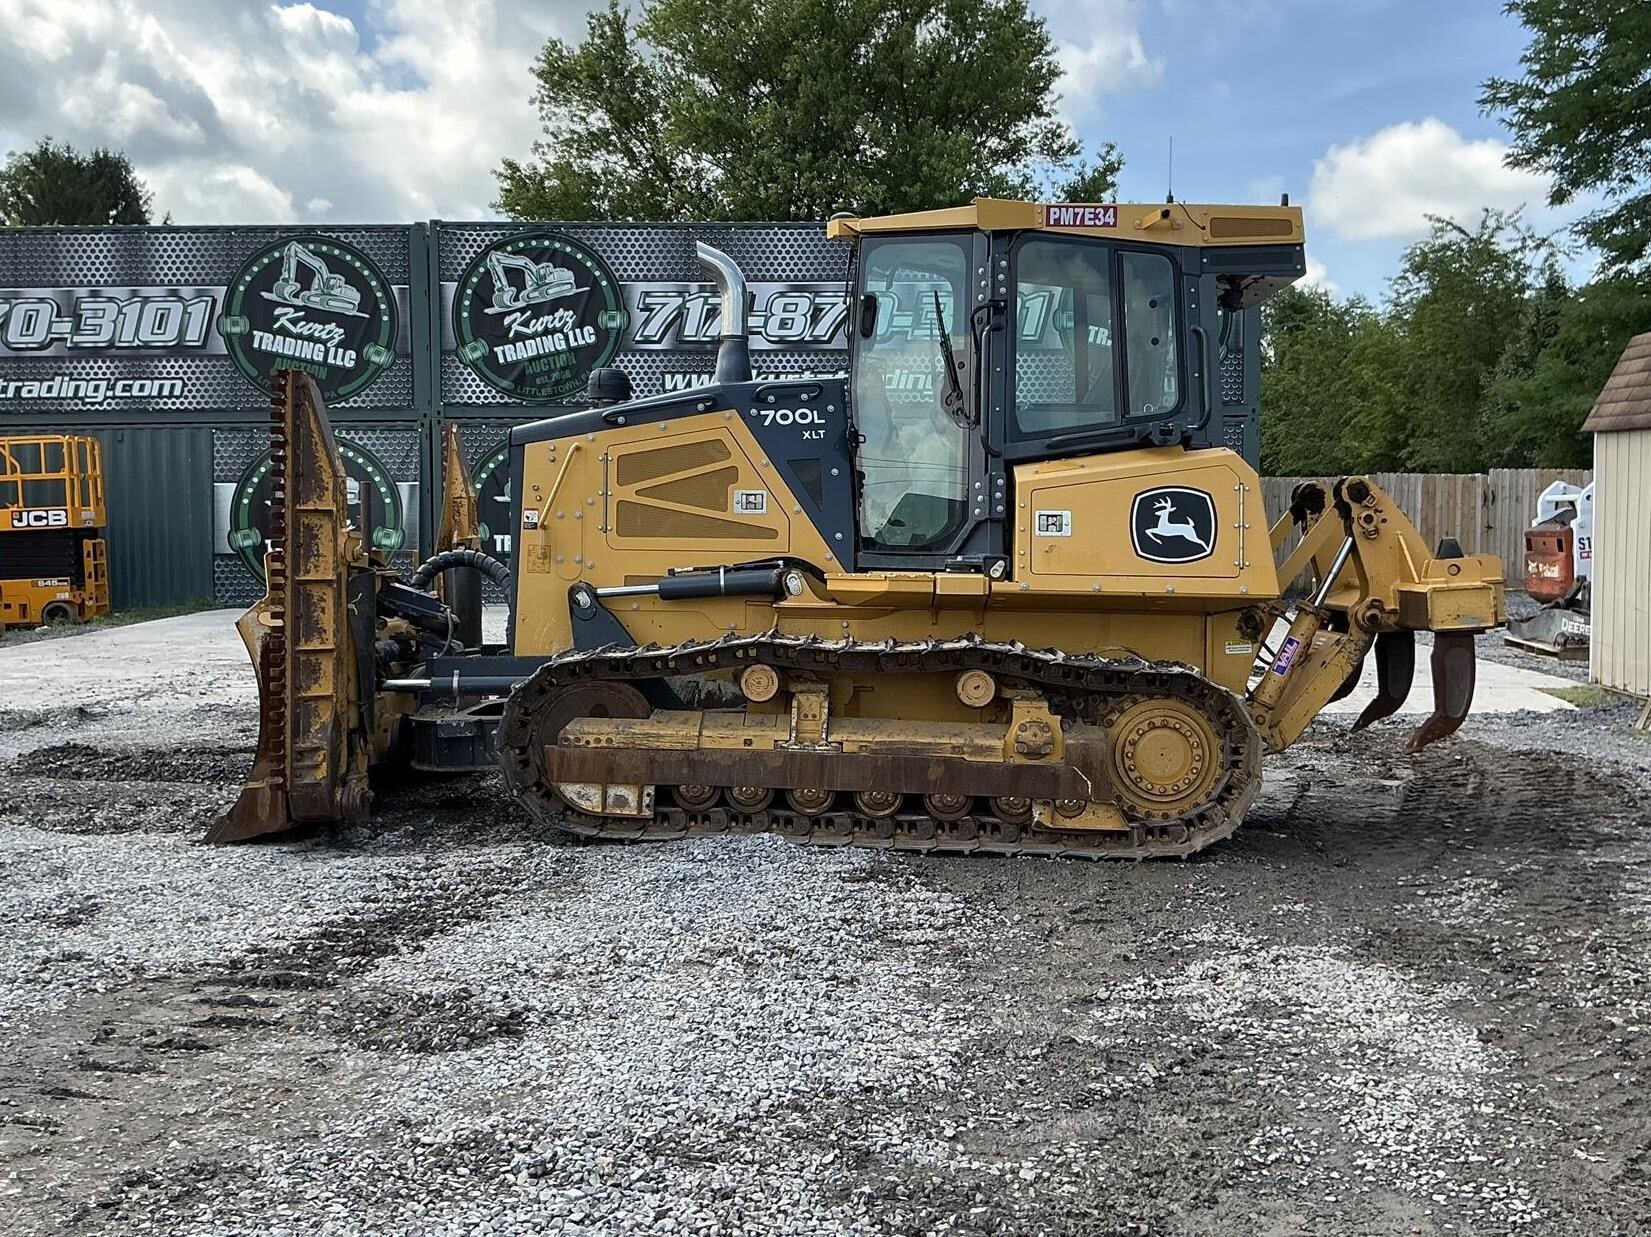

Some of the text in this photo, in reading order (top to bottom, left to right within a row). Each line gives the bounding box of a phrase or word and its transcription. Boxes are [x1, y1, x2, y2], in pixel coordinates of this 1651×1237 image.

[1049, 207, 1114, 226] PM7E34
[273, 306, 345, 347] Kurtz
[504, 308, 576, 338] Kurtz
[253, 331, 357, 368] TRADING LLC
[494, 326, 596, 363] TRADING LLC
[525, 351, 576, 375] AUCTION
[760, 408, 825, 426] 700L
[802, 429, 826, 440] XLT
[12, 510, 67, 527] JCB
[1561, 617, 1591, 637] DEERE
